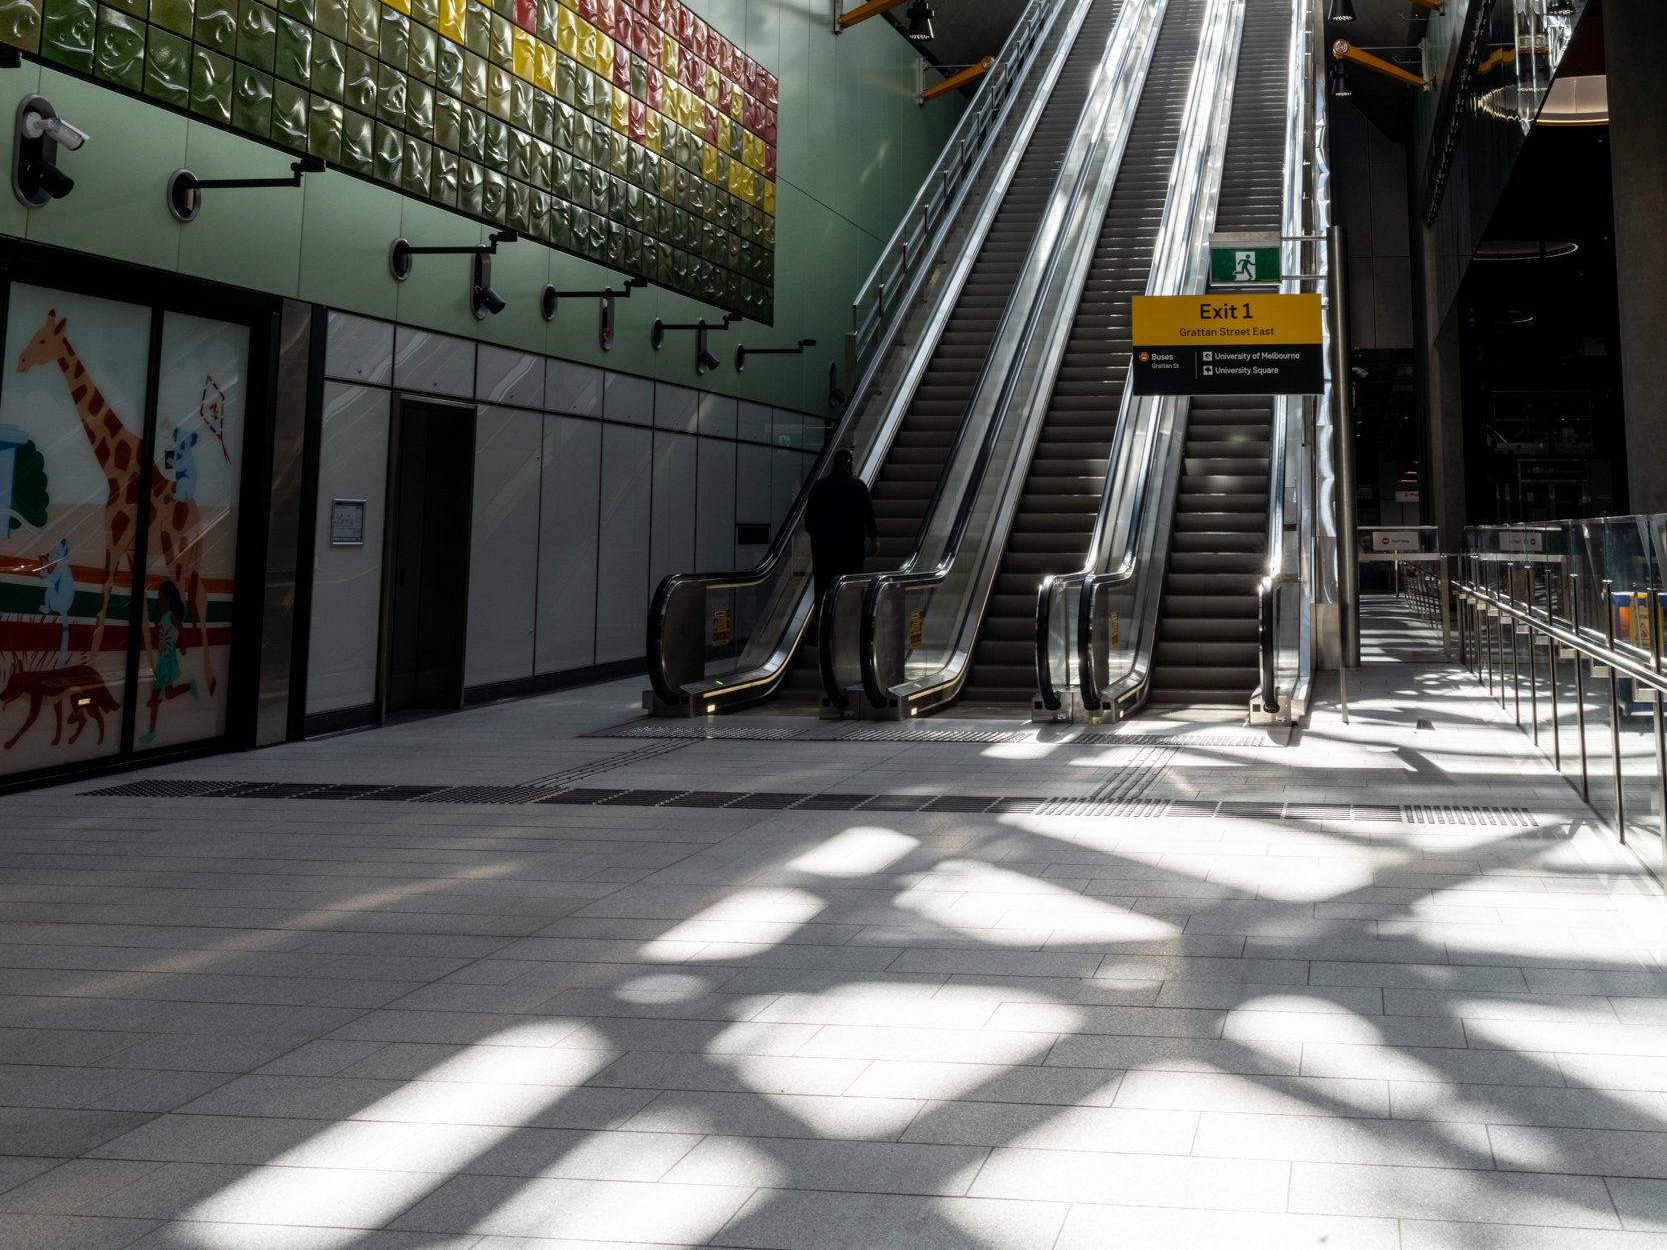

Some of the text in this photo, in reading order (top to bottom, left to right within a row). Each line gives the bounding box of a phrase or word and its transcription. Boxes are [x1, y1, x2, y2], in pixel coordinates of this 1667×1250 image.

[1200, 303, 1253, 319] Exit 1
[1179, 327, 1275, 337] Grattan Street East
[1151, 353, 1174, 361] Buses
[1214, 351, 1300, 361] University of Melbourne
[1215, 366, 1279, 376] University Square
